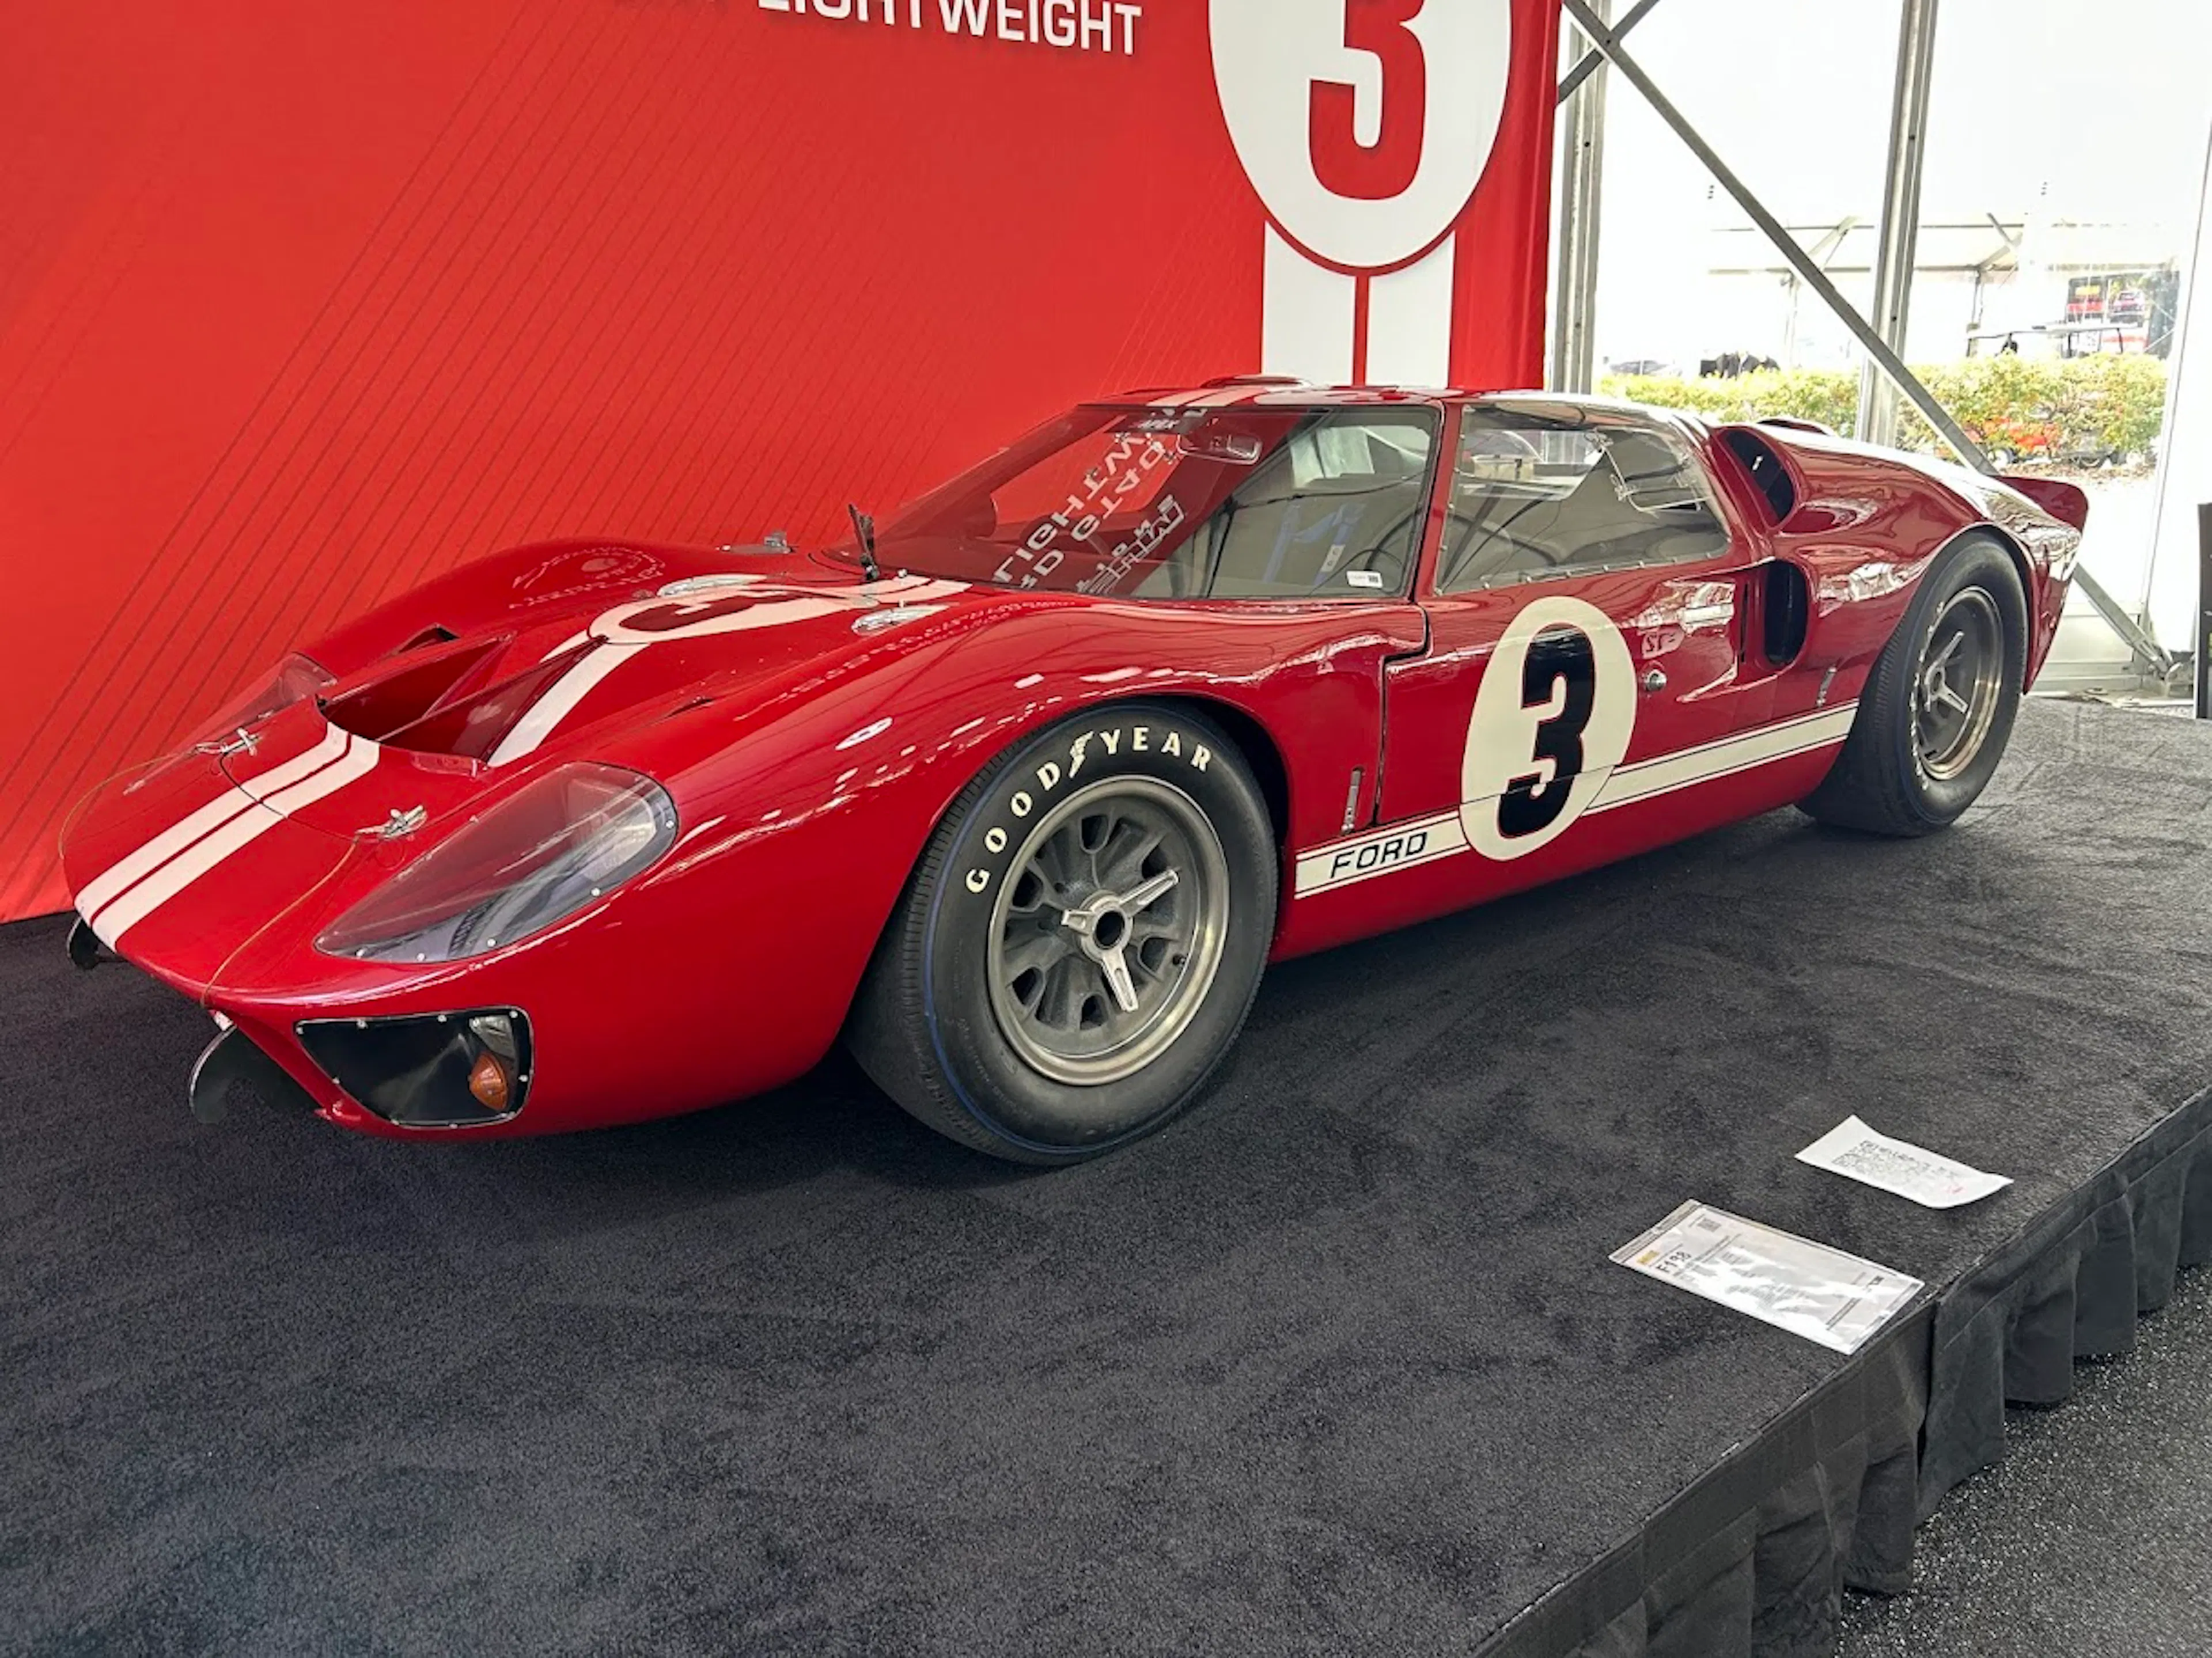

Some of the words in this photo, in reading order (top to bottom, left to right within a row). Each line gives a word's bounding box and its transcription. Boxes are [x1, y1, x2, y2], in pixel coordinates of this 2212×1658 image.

[757, 0, 1142, 55] WEIGHT
[1498, 622, 1595, 839] 3
[965, 726, 1211, 894] GOODYEAR
[1330, 832, 1428, 879] FORD
